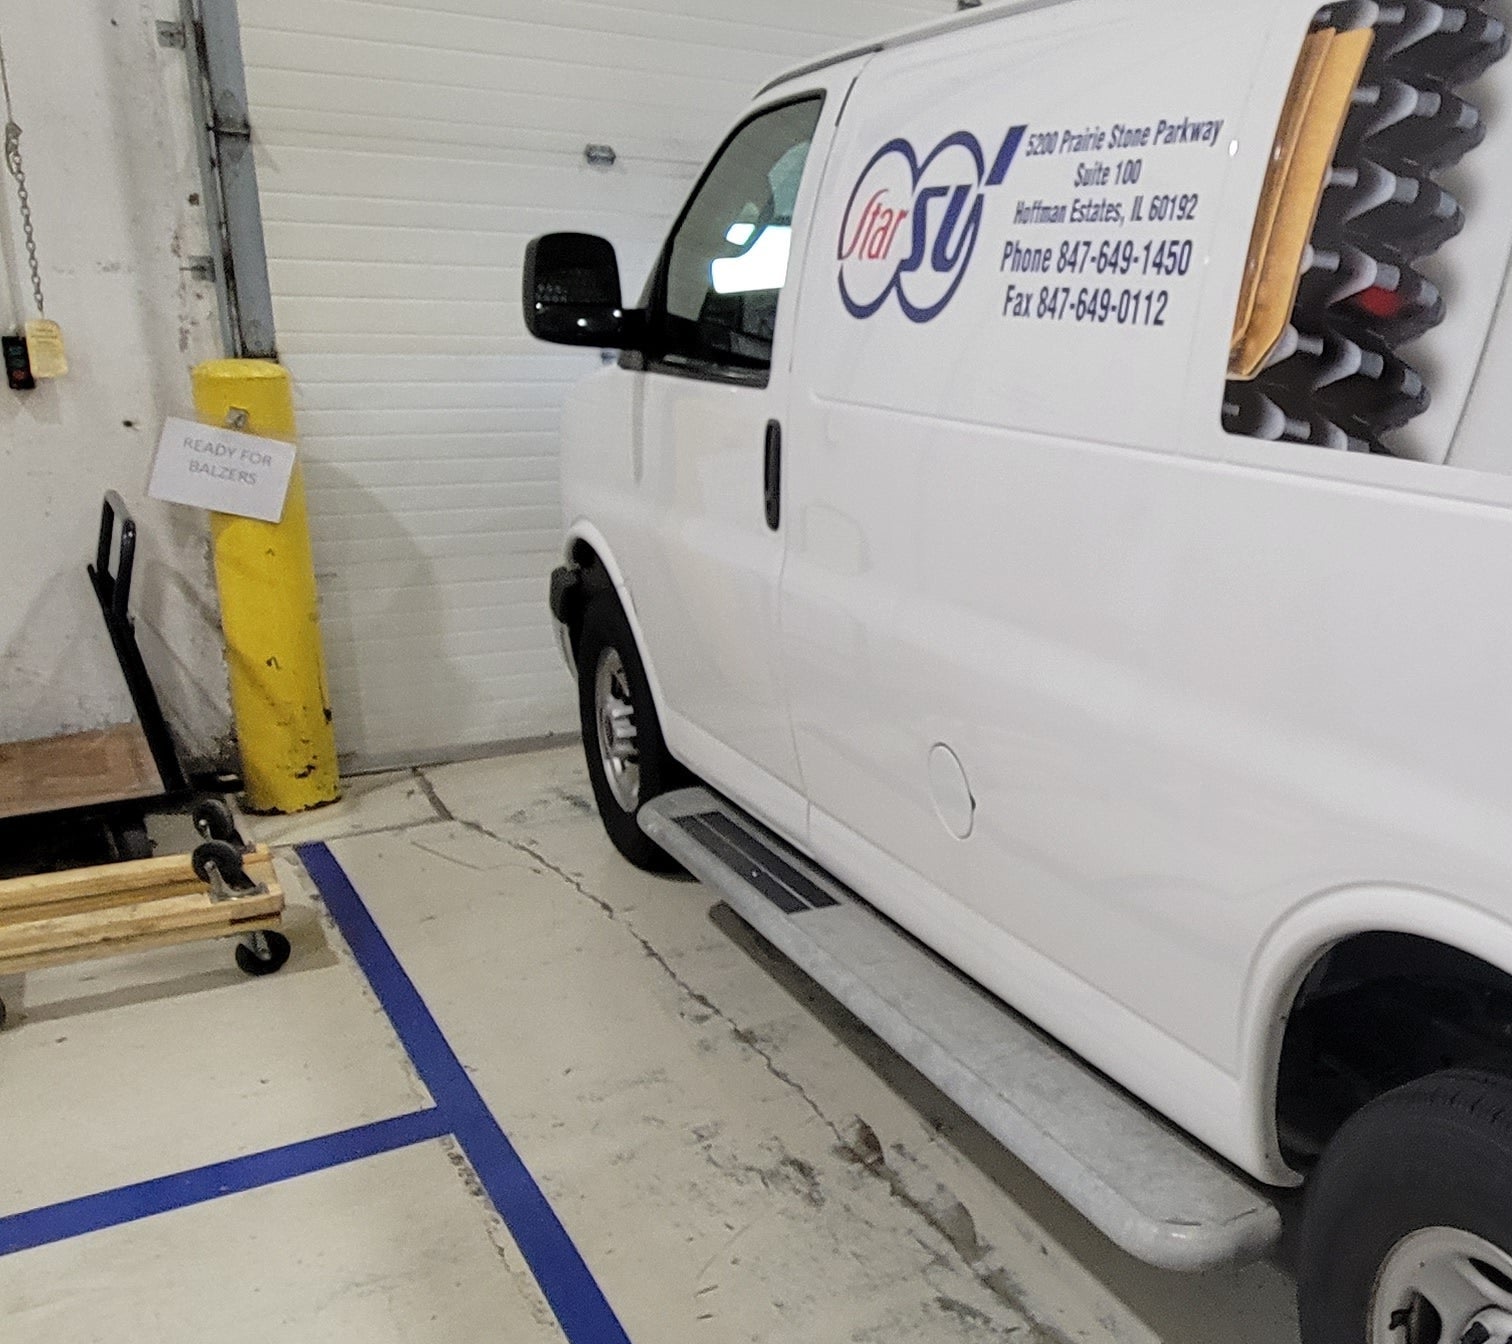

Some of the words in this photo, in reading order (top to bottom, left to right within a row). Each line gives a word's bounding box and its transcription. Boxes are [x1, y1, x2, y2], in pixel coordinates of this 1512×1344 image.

[1026, 130, 1058, 157] 5200
[1059, 126, 1106, 154] Prairie
[1108, 123, 1151, 149] Stone
[1153, 117, 1224, 147] Parkway
[1074, 160, 1110, 188] Suite
[1114, 159, 1142, 185] 100
[1012, 199, 1067, 225] Hoffman
[1070, 197, 1125, 227] Estates,
[1130, 195, 1144, 222] IL
[1149, 193, 1198, 222] 60192
[1000, 240, 1052, 273] Phone
[1056, 239, 1193, 276] 847-649-1450
[1003, 284, 1033, 317] Fax
[1037, 286, 1169, 326] 847-649-0112
[183, 436, 238, 458] READY
[240, 447, 272, 467] FOR
[188, 459, 257, 486] BALZERS
